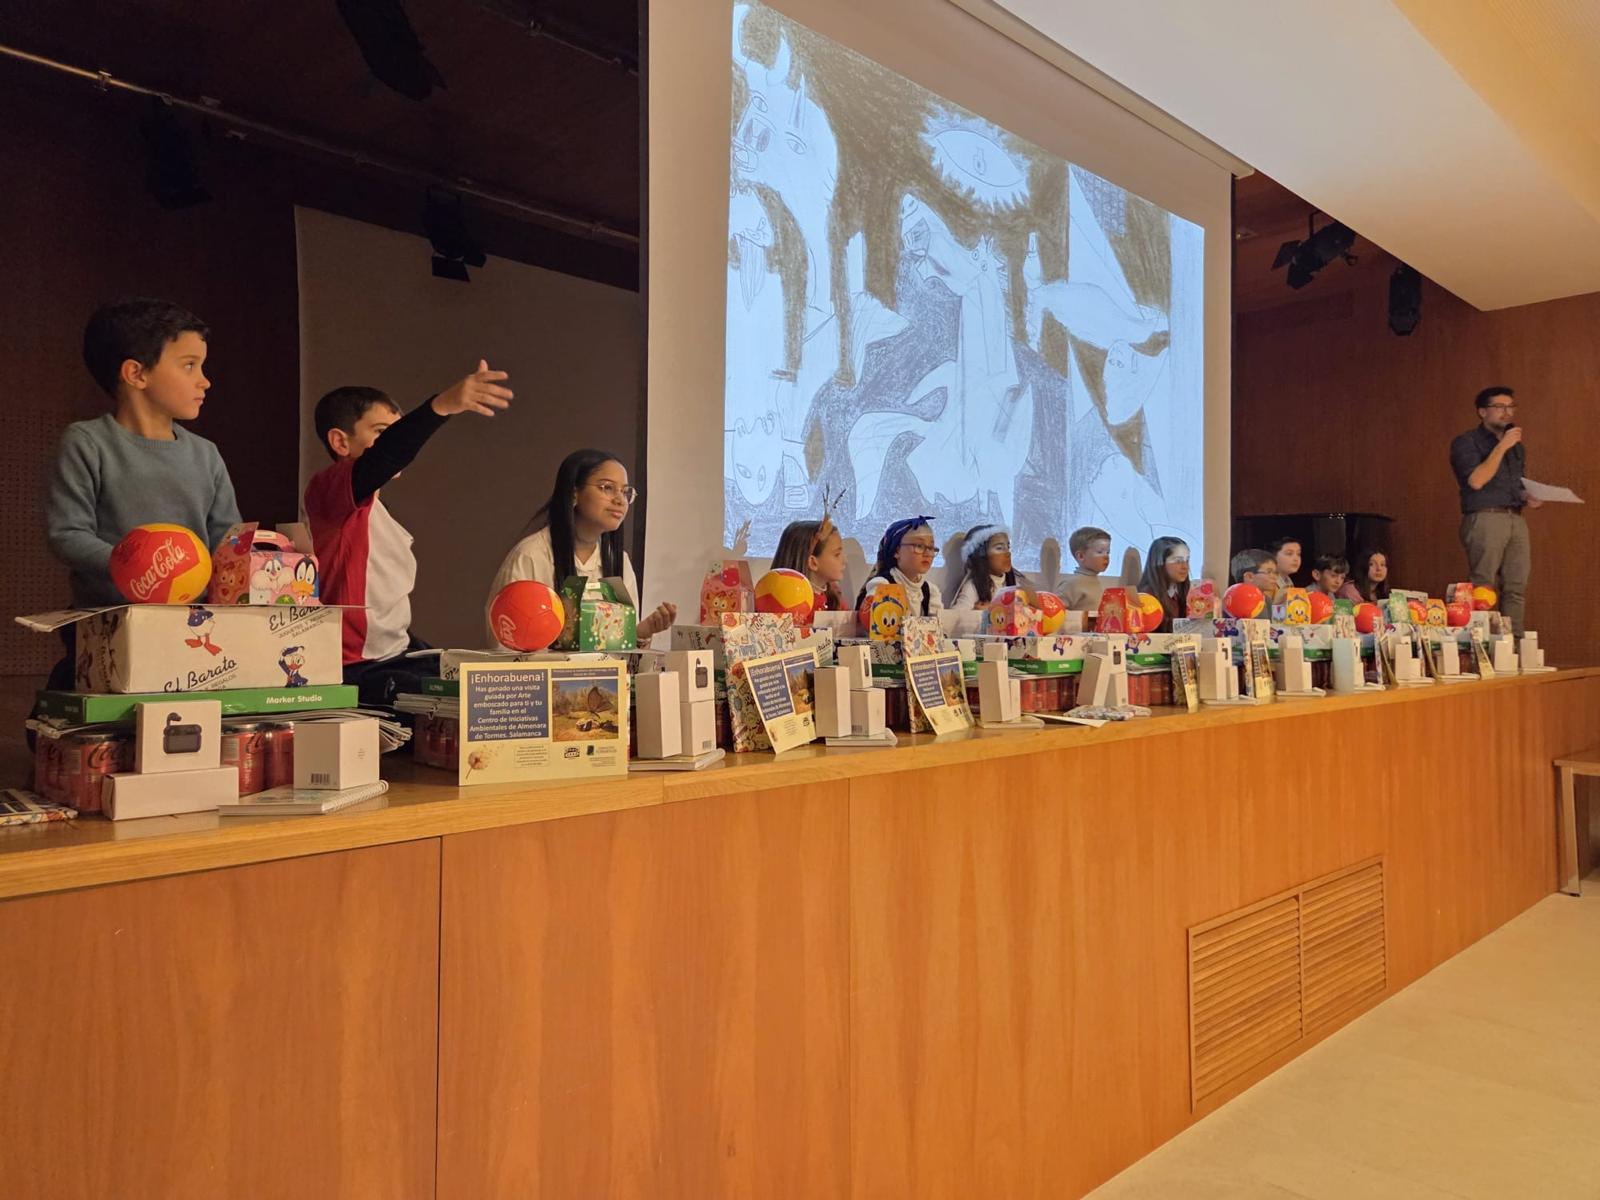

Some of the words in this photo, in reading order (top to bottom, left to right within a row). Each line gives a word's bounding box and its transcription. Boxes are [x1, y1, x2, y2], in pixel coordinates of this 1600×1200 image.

[130, 537, 186, 600] Coca-Cola
[269, 612, 285, 631] El
[187, 656, 237, 689] Barato
[471, 672, 545, 684] ¡Enhorabuena!
[488, 685, 511, 693] ganado
[266, 696, 295, 704] Marker
[297, 694, 322, 703] Studio
[484, 693, 506, 701] guiada
[473, 701, 509, 709] emboscado
[469, 724, 508, 732] Ambientales
